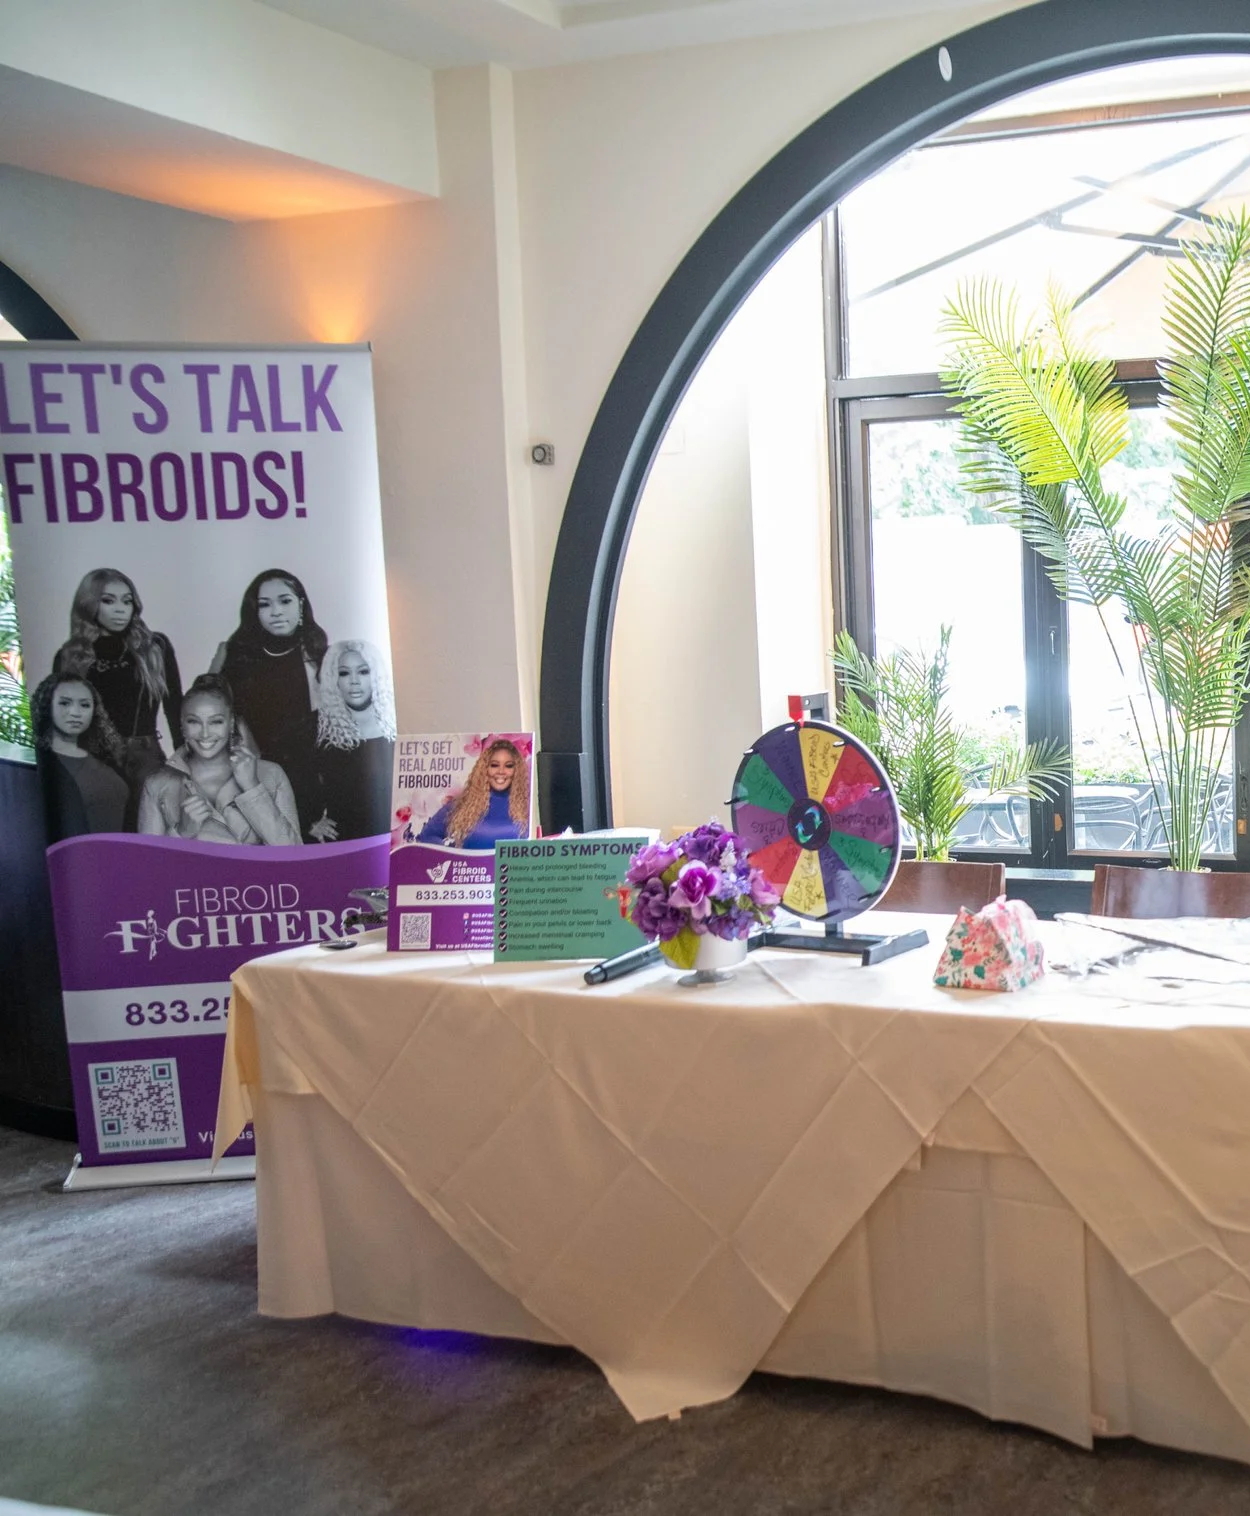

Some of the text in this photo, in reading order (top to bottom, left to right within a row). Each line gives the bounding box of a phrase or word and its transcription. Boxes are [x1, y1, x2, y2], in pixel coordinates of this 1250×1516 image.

[0, 363, 344, 435] LET'S TALK
[3, 450, 308, 524] FIBROIDS!
[400, 741, 453, 756] LET'S GET
[399, 757, 466, 772] REAL ABOUT
[398, 774, 452, 789] FIBROIDS!
[500, 843, 643, 858] FIBROID SYMPTOMS
[452, 867, 487, 875] FIBROID
[509, 864, 529, 872] Heavy
[545, 863, 577, 872] prolonged
[580, 862, 607, 871] bleeding
[452, 874, 492, 883] CENTERS
[594, 873, 617, 882] fatigue
[416, 889, 494, 900] 833.253.903
[525, 886, 545, 895] during
[175, 884, 300, 914] FIBROID
[509, 898, 537, 906] Frequent
[509, 909, 549, 918] Constipation
[572, 908, 598, 917] bloating
[548, 919, 567, 928] pelvis
[542, 931, 573, 939] menstrual
[575, 931, 605, 939] cramping
[538, 943, 564, 951] swelling
